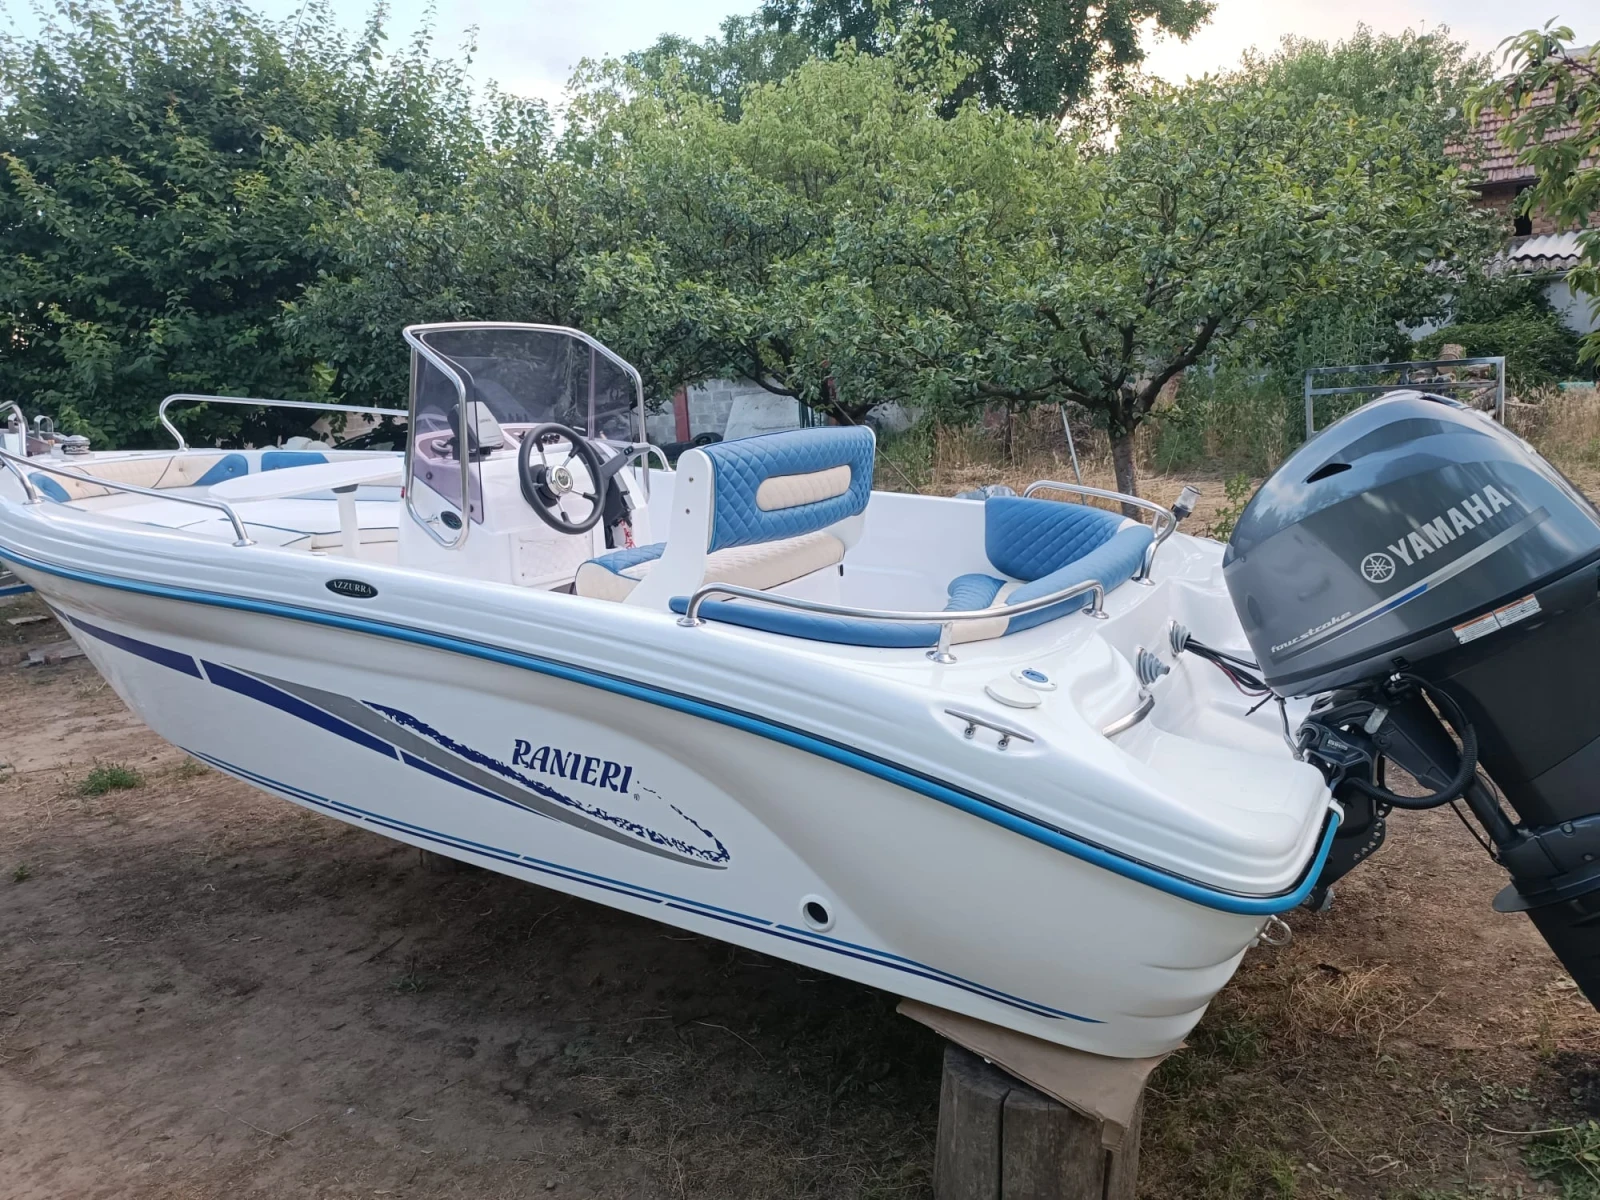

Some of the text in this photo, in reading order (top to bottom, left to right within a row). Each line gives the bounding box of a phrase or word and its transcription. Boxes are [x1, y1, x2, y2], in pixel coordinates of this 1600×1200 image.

[1387, 484, 1513, 567] YAMAHA
[333, 581, 372, 595] AZZURRA
[512, 739, 633, 794] RANIERI
